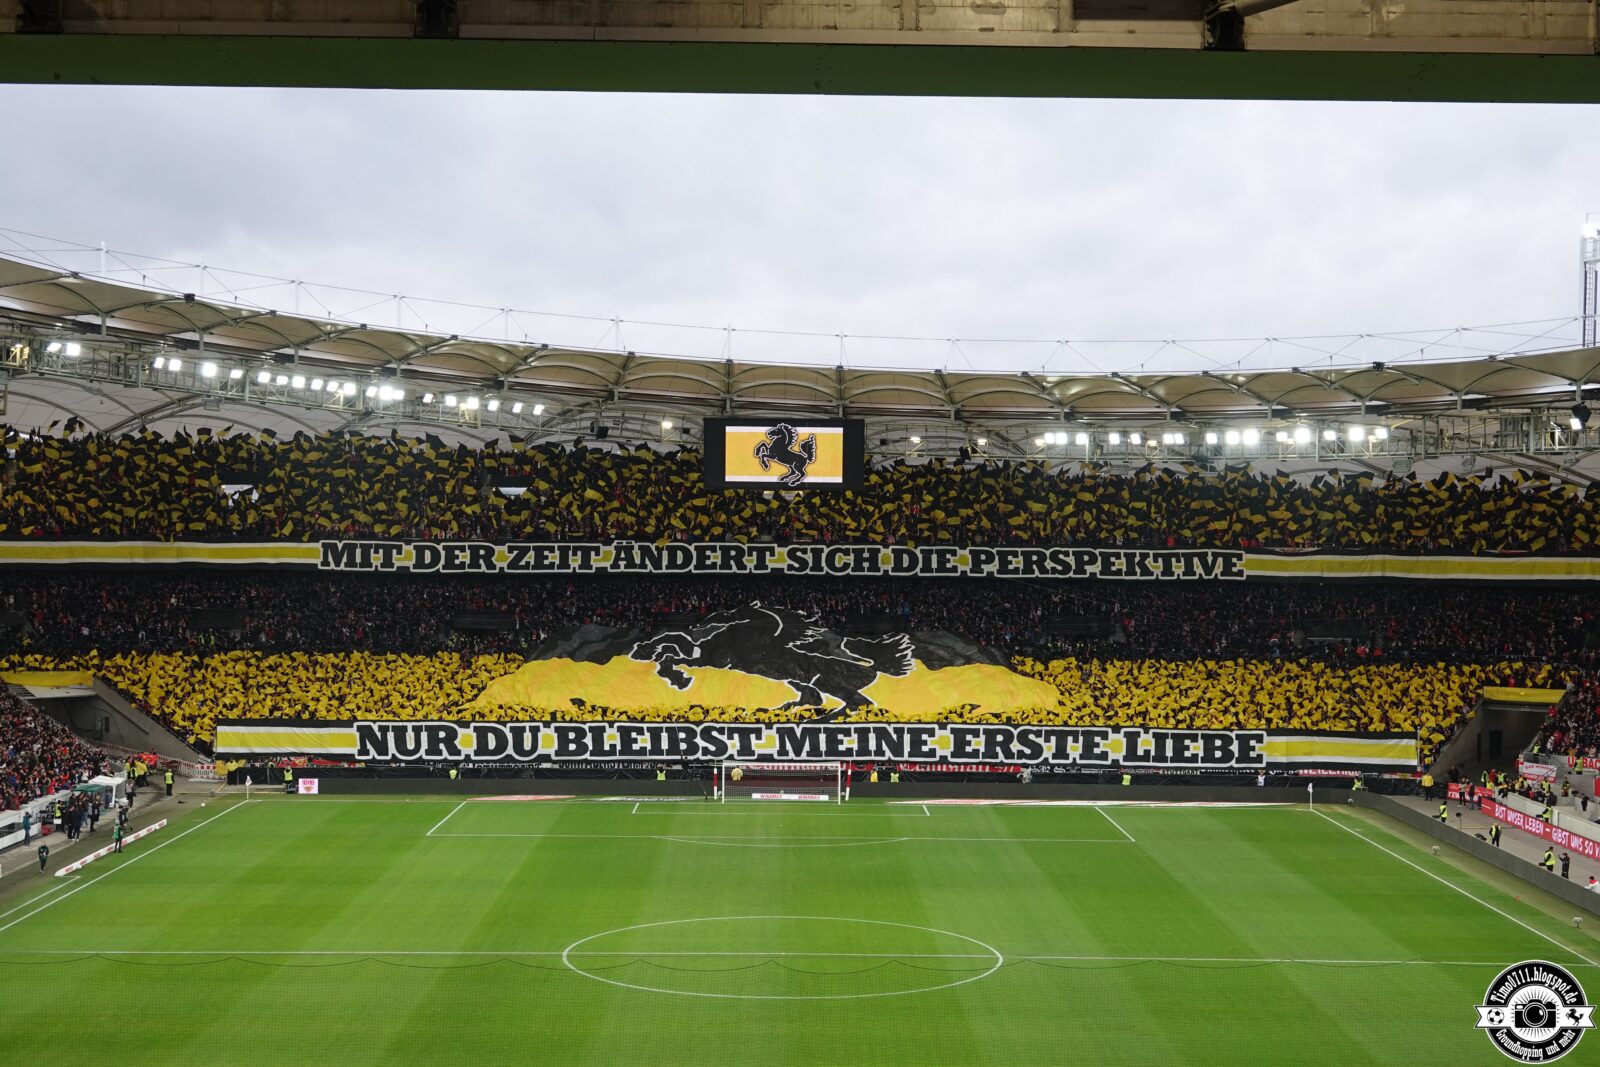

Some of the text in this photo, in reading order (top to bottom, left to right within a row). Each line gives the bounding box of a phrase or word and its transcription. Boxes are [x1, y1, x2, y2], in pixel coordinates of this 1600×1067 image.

[320, 541, 1246, 579] MIT DER ZEIT ÄNDERT SICH DIE PERSPEKTIVE
[355, 722, 1267, 767] NUR DU BLEIBST MEINE ERSTE LIEBE
[1507, 809, 1525, 830] UNSER
[1525, 815, 1544, 836] LEBEN
[1552, 828, 1570, 847] GIBST
[1571, 834, 1583, 851] UNS
[1584, 839, 1593, 856] SO
